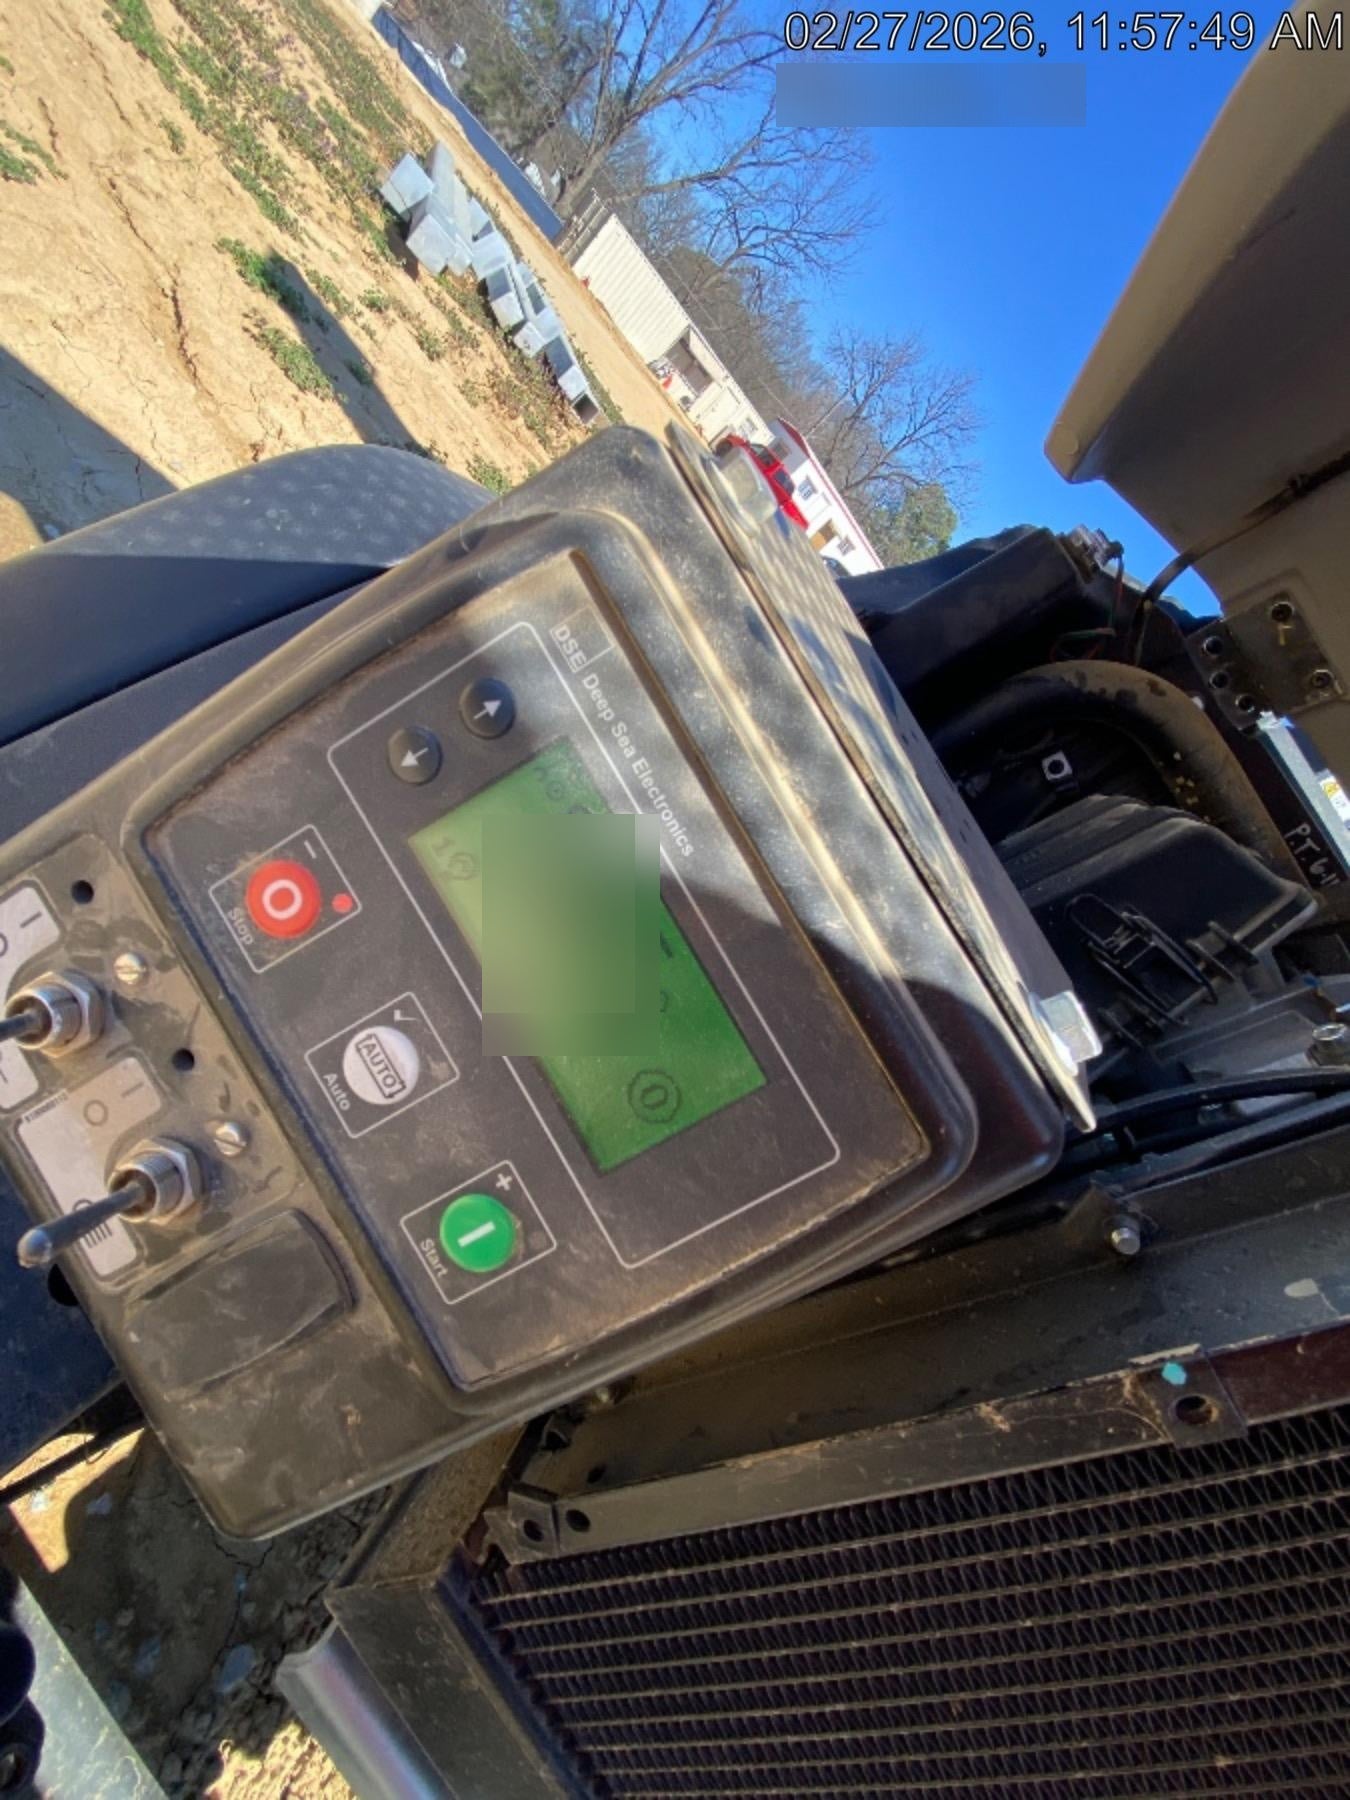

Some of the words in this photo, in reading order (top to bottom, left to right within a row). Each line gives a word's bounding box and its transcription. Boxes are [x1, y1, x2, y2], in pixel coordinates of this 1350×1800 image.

[555, 624, 587, 668] DSE
[582, 673, 615, 721] Deep
[611, 722, 635, 760] Sea
[631, 757, 694, 857] Electronics
[228, 907, 254, 946] Stop
[363, 1040, 396, 1091] AUTO
[323, 1072, 351, 1113] Auto
[420, 1237, 449, 1278] Start
